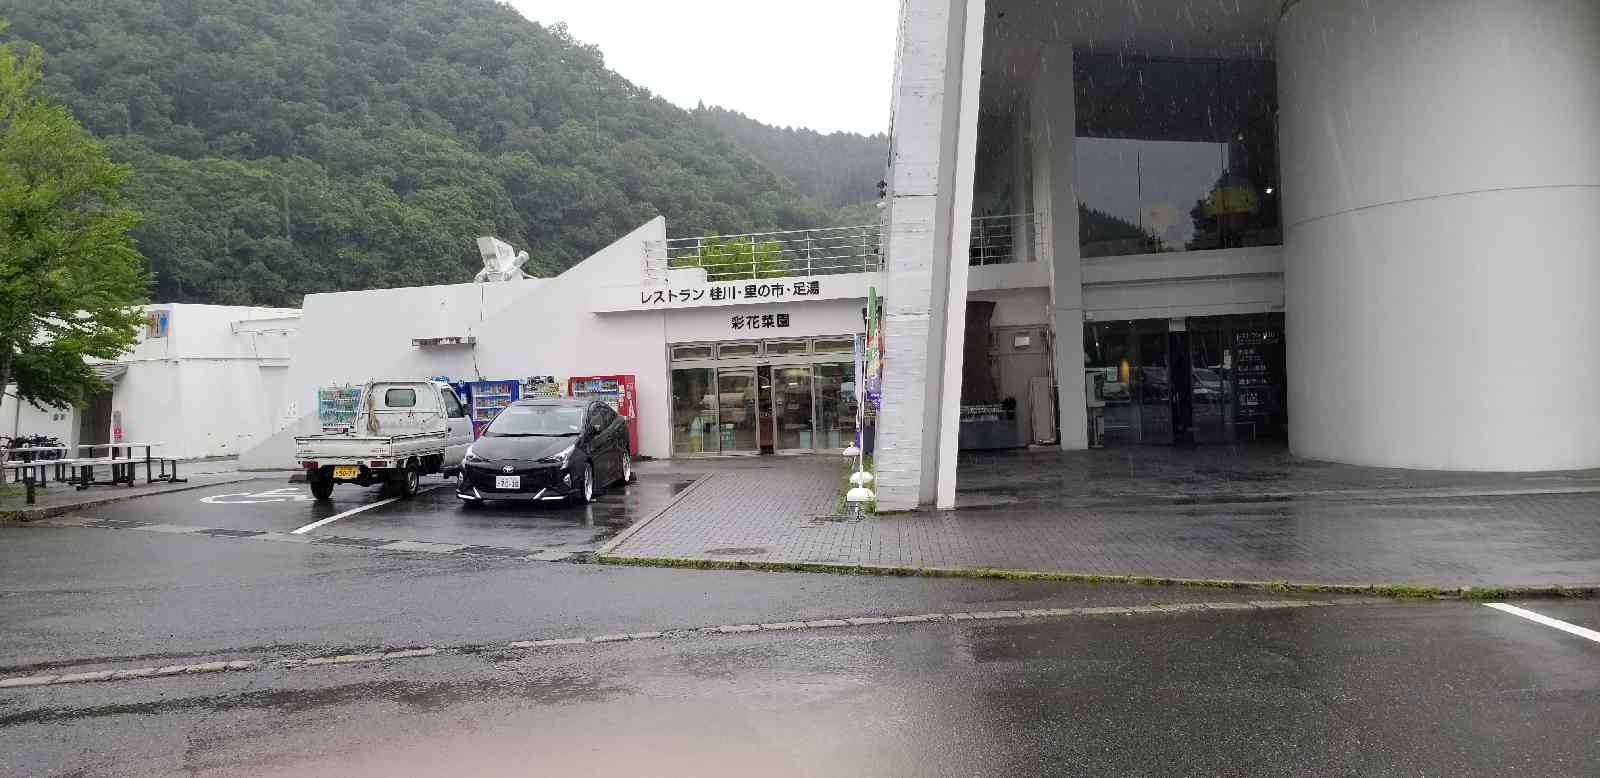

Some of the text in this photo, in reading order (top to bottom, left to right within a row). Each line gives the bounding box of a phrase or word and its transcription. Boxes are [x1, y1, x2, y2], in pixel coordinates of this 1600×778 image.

[641, 289, 705, 305] レストラン
[731, 313, 790, 330] 彩花菜園
